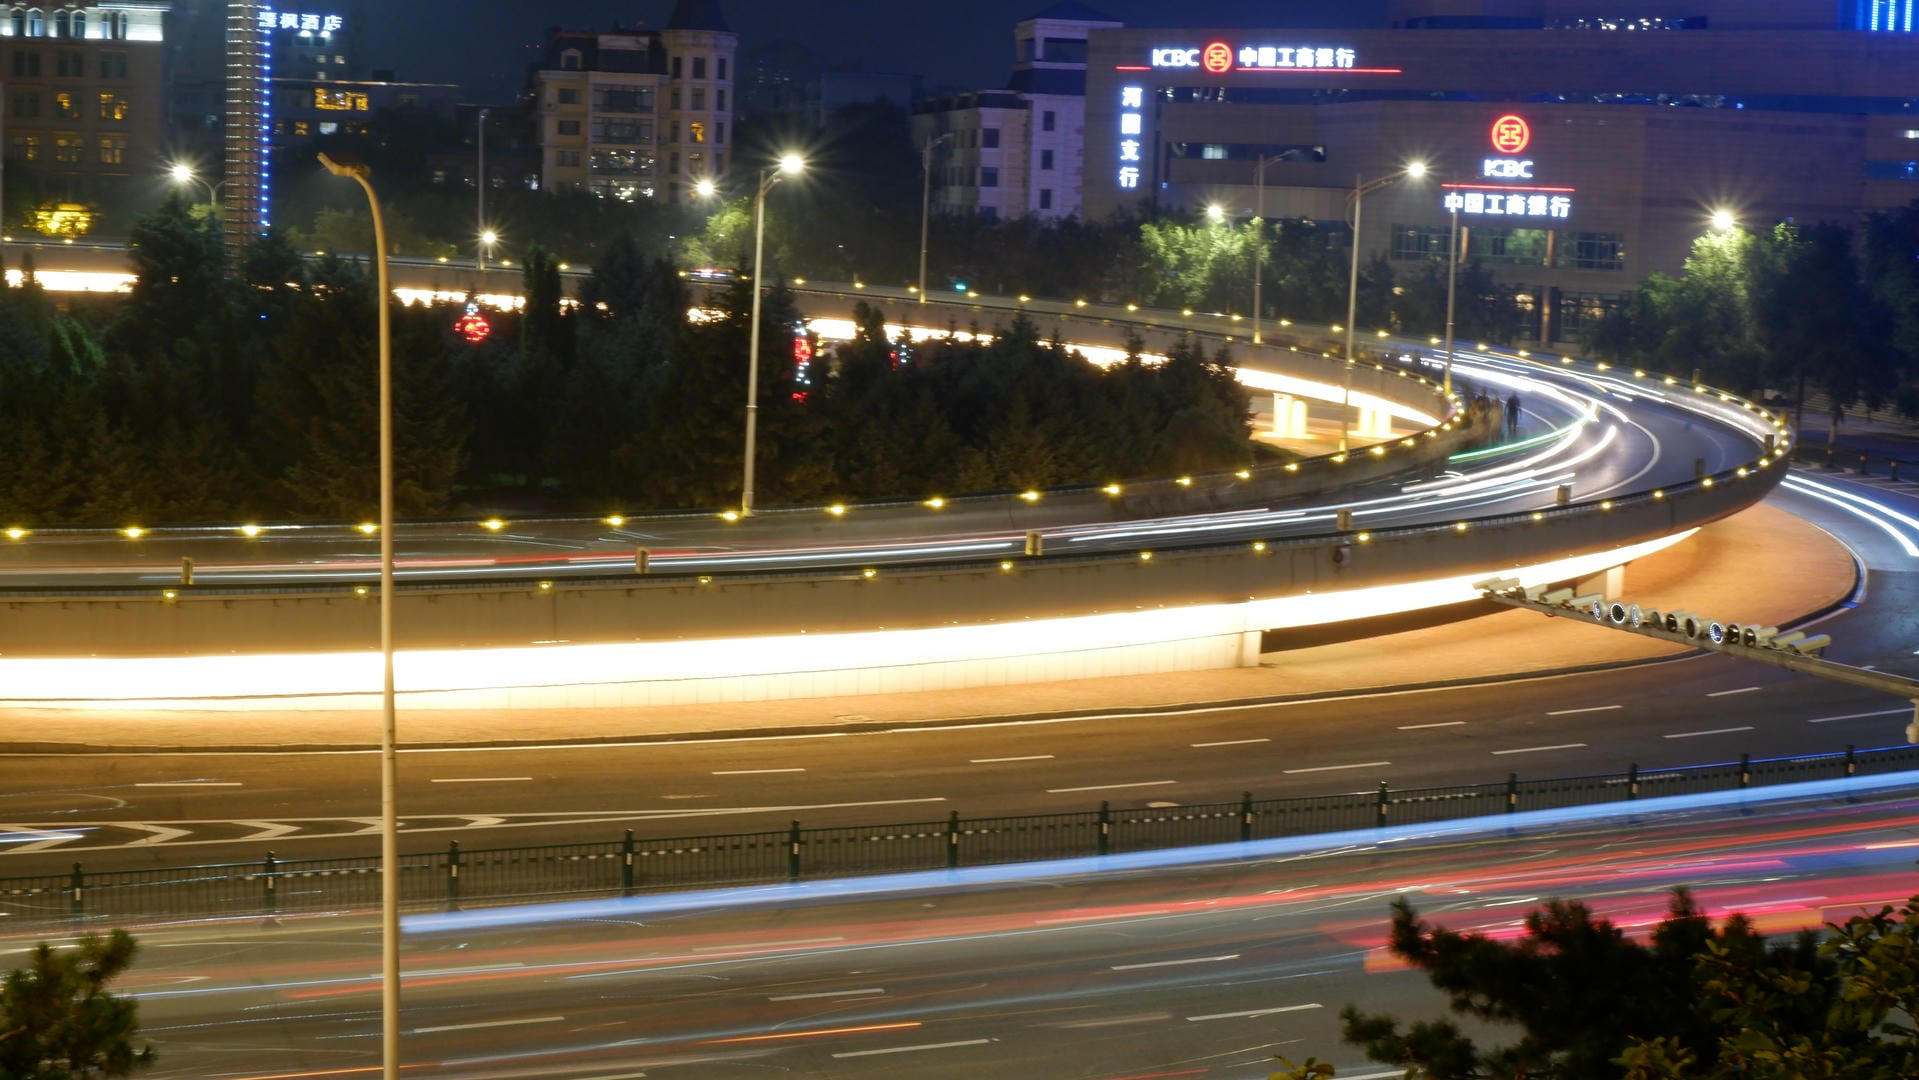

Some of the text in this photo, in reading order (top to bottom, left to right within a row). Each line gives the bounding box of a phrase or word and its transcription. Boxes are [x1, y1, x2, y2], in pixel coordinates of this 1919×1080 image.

[1152, 47, 1356, 68] ICBC 中国工商银行
[1483, 159, 1534, 178] ICBC
[1444, 192, 1571, 217] 中国工商银行
